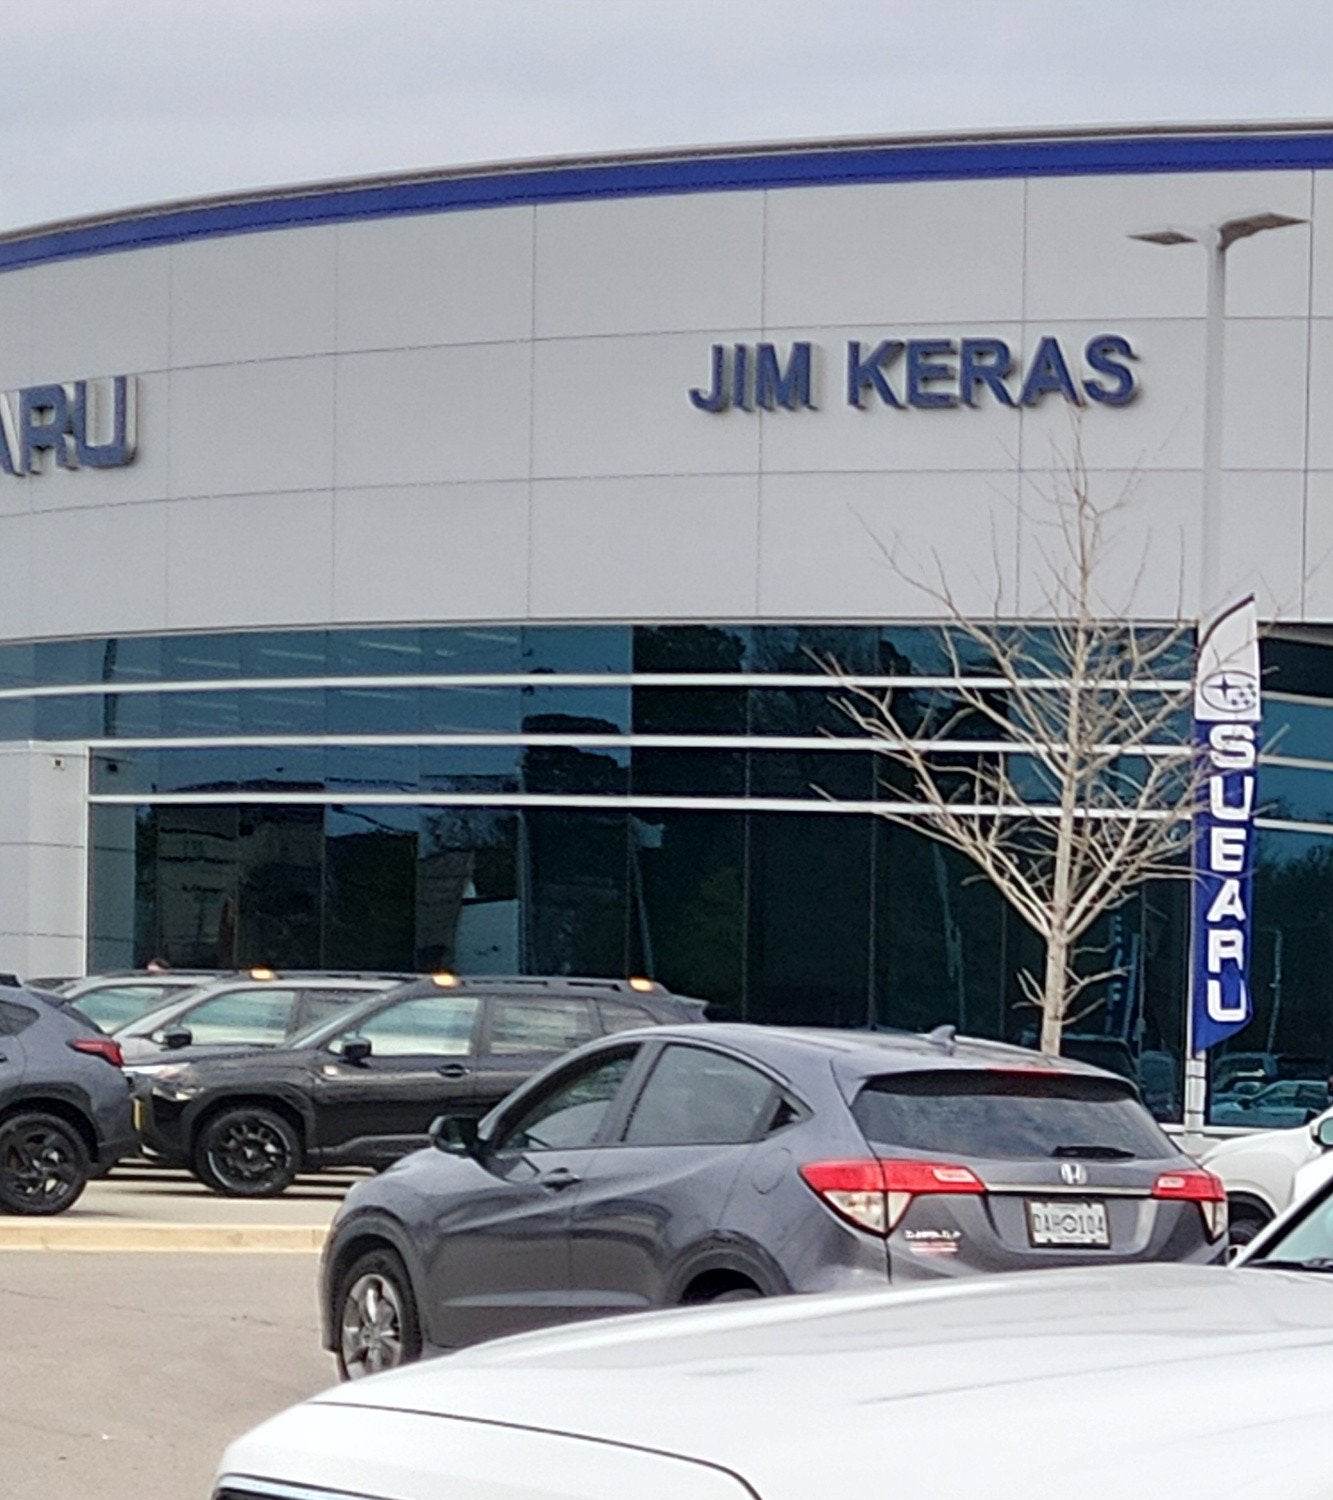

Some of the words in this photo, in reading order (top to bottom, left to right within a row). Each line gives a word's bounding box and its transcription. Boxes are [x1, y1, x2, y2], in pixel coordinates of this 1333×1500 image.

[689, 341, 820, 412] JIM
[847, 334, 1141, 411] KERAS
[1208, 724, 1255, 1022] SUBARU
